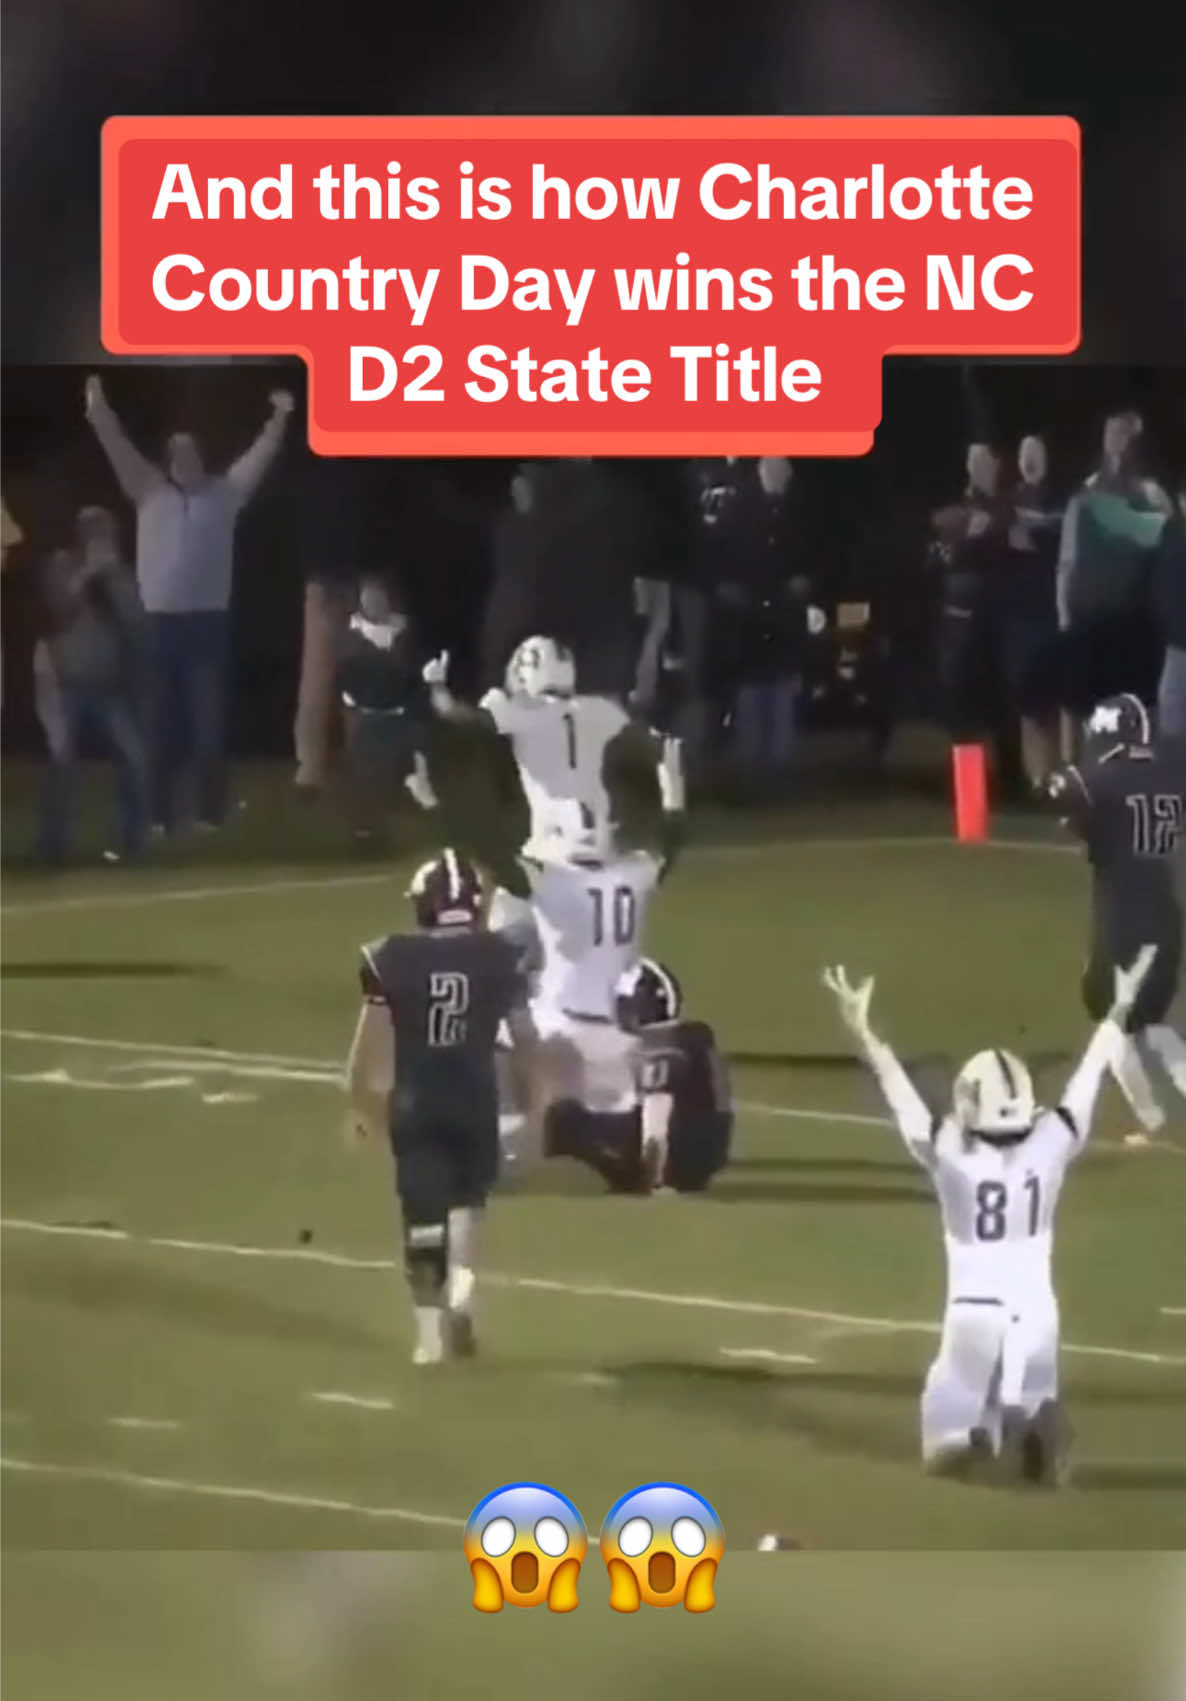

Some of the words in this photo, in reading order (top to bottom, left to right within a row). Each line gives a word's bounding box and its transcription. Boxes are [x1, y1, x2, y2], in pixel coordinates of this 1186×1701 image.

[562, 712, 578, 771] 1
[588, 886, 636, 947] 10
[428, 972, 469, 1047] 2
[975, 1175, 1040, 1242] 81
